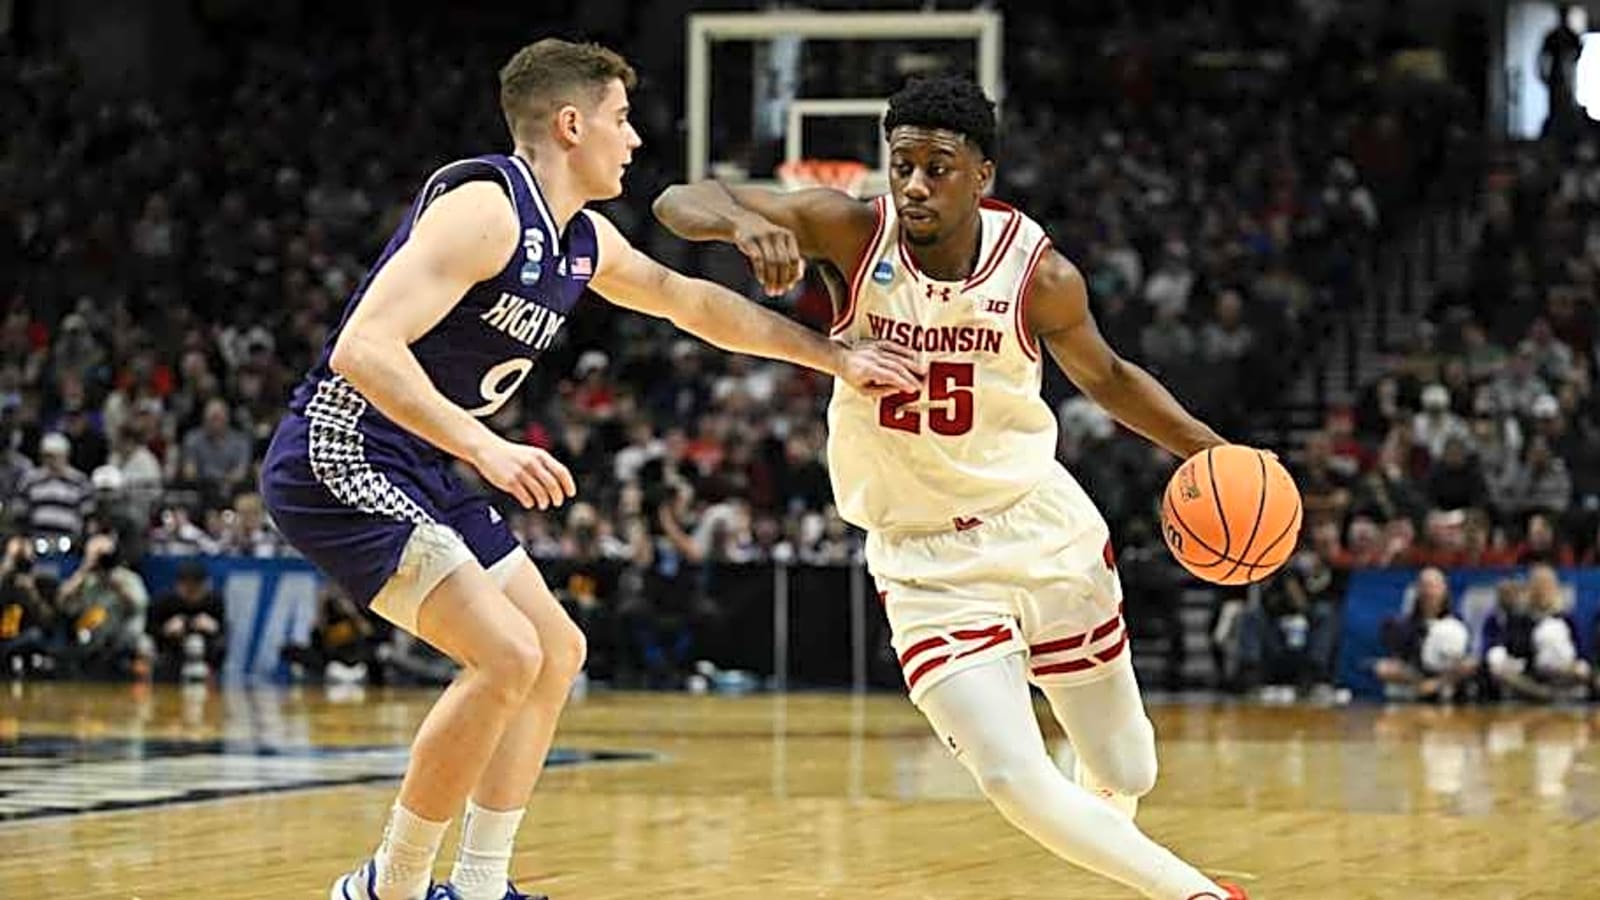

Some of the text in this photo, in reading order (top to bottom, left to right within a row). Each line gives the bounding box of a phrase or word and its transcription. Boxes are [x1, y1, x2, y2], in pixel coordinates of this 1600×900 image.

[480, 292, 548, 345] HIGH
[867, 313, 1003, 354] WISCONSIN
[471, 357, 534, 417] 9
[879, 361, 974, 436] 25
